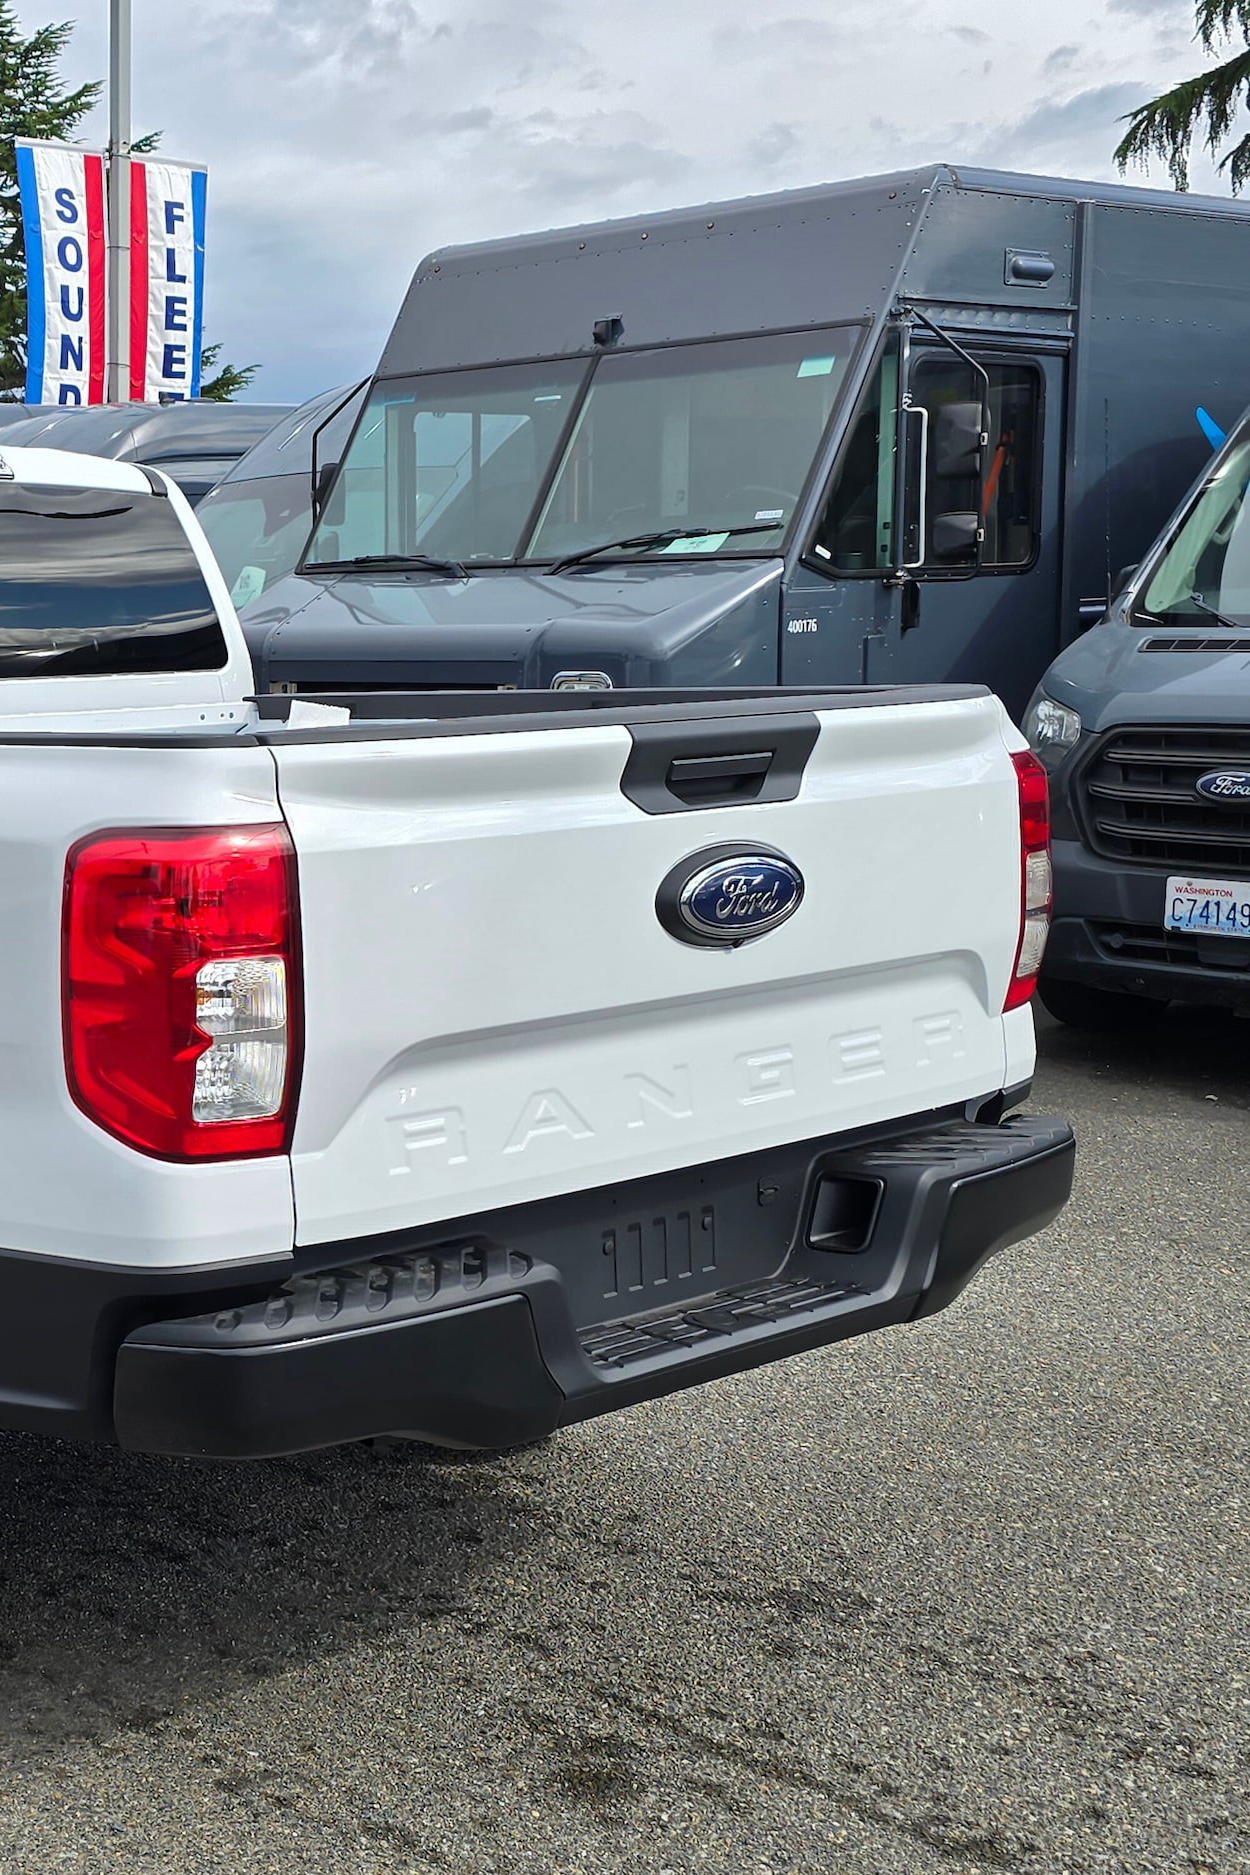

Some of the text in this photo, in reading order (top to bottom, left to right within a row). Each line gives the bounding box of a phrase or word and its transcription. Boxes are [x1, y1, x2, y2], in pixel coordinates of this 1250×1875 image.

[159, 200, 187, 401] FLEE
[787, 619, 818, 633] 400176
[716, 874, 780, 919] Ford
[1175, 886, 1233, 897] WASHINGTON
[385, 1010, 966, 1176] RANGER
